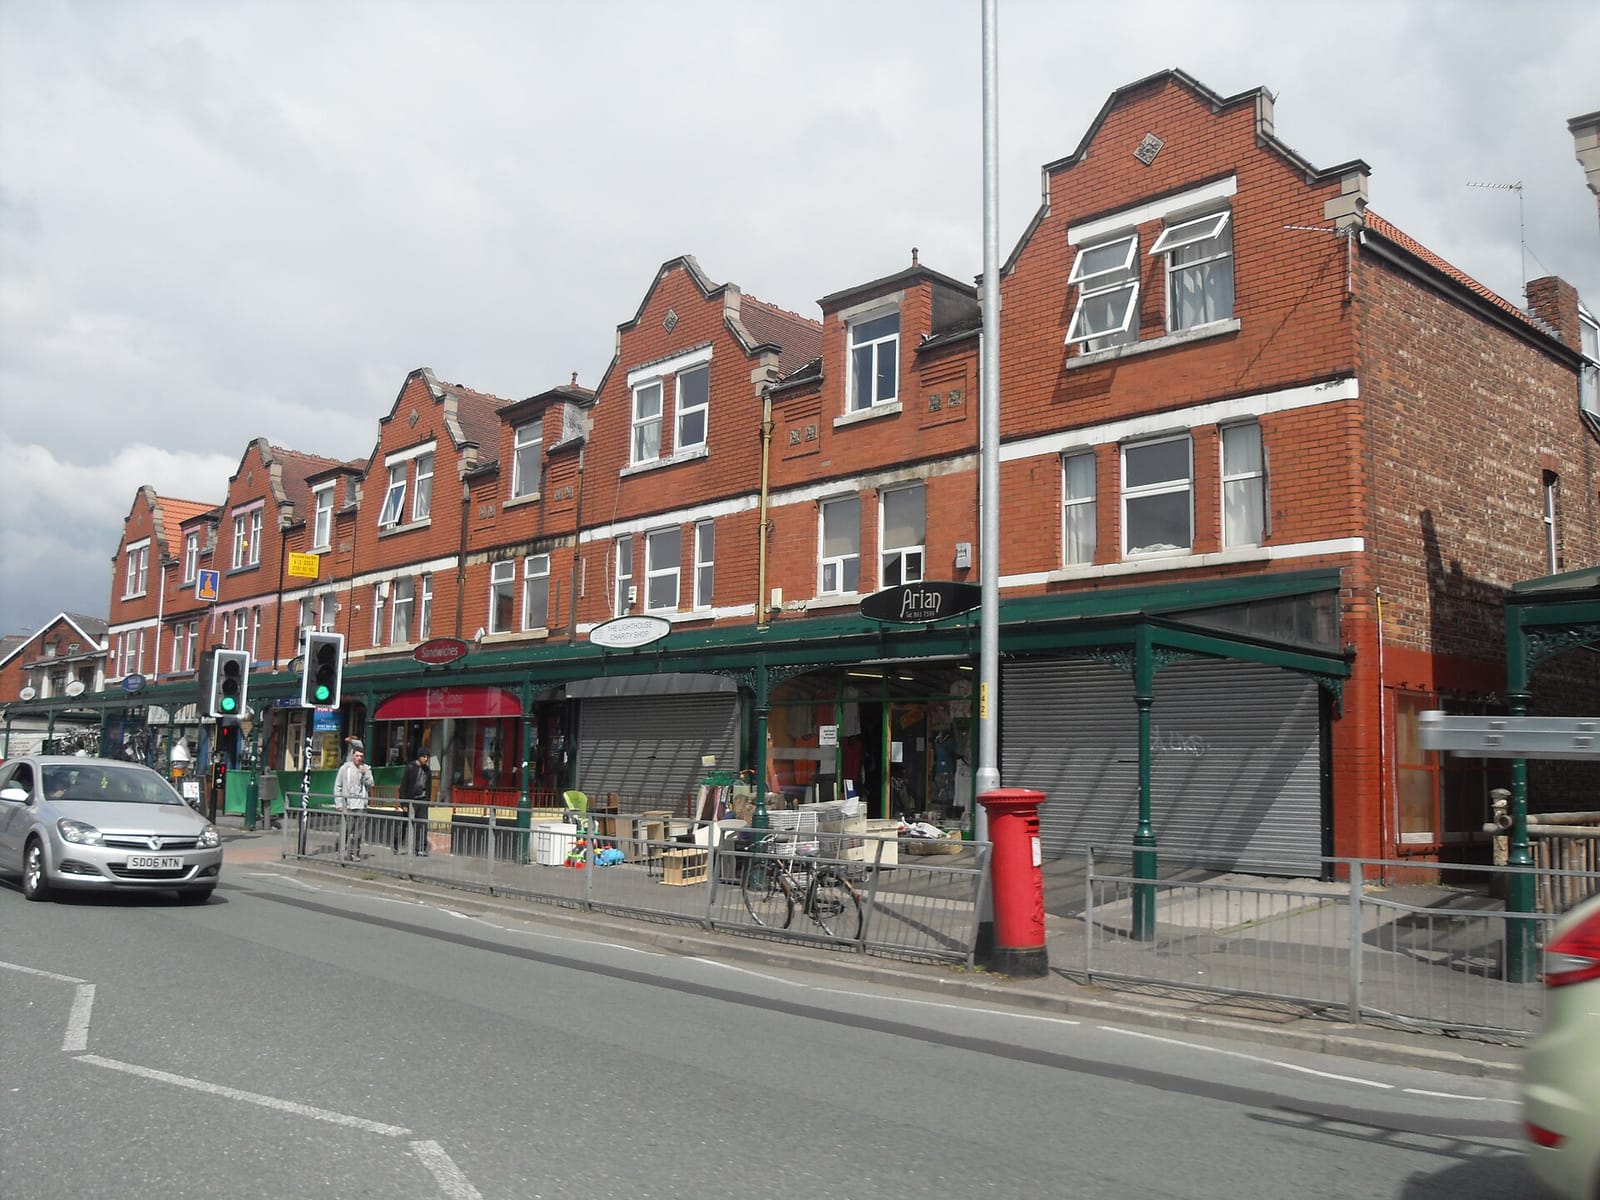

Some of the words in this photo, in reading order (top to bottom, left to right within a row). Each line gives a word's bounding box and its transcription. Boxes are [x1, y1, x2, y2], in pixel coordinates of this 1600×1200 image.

[900, 588, 942, 618] Arian
[607, 624, 618, 632] THE
[618, 620, 653, 631] LIGHTHOUSE
[610, 632, 632, 641] CHARITY
[633, 630, 649, 639] SHOP
[422, 645, 458, 658] Sandwiches
[132, 857, 160, 868] SD06
[161, 858, 180, 868] NTN
